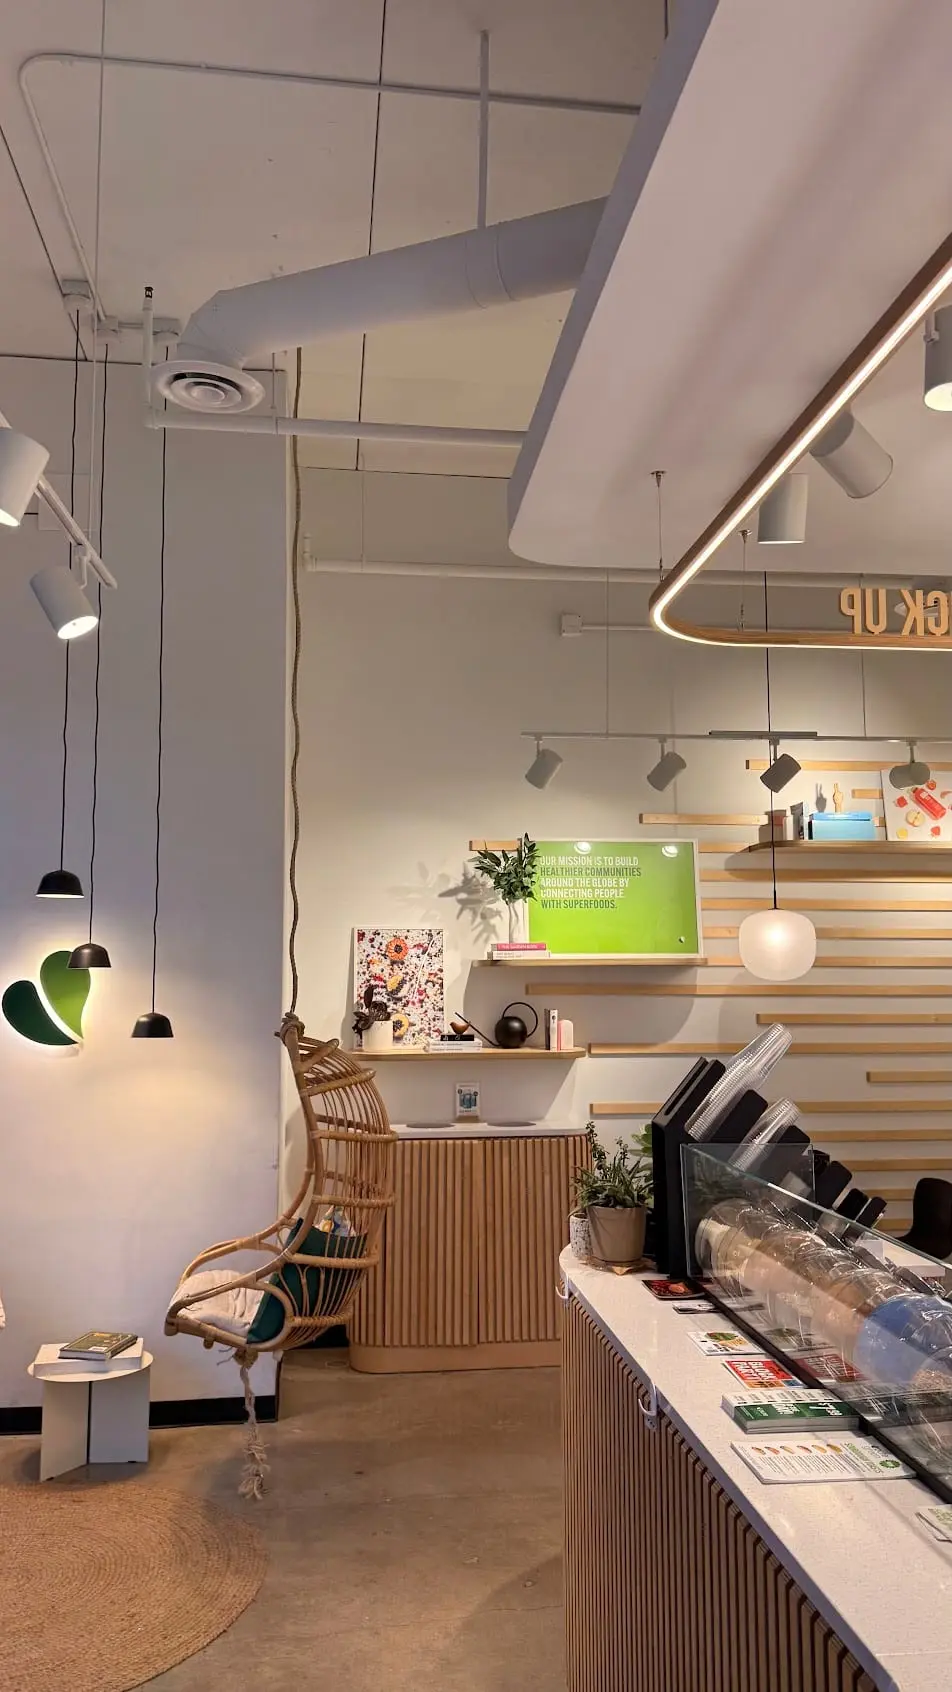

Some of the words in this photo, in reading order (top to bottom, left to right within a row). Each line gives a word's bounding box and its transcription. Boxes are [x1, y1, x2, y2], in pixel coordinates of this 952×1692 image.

[541, 856, 556, 866] OUR
[558, 856, 592, 866] MISSION
[594, 856, 602, 866] IS
[604, 856, 613, 866] TO
[615, 856, 639, 866] BUILD
[540, 867, 583, 877] HEALTHIER
[585, 867, 641, 877] COMMUNITIES
[541, 878, 574, 888] AROUND
[576, 878, 590, 888] THE
[592, 878, 617, 888] GLOBE
[620, 878, 629, 888] BY
[541, 888, 593, 898] CONNECTING
[594, 888, 625, 898] PEOPLE
[542, 899, 561, 909] WITH
[563, 899, 617, 909] SUPERFOODS.
